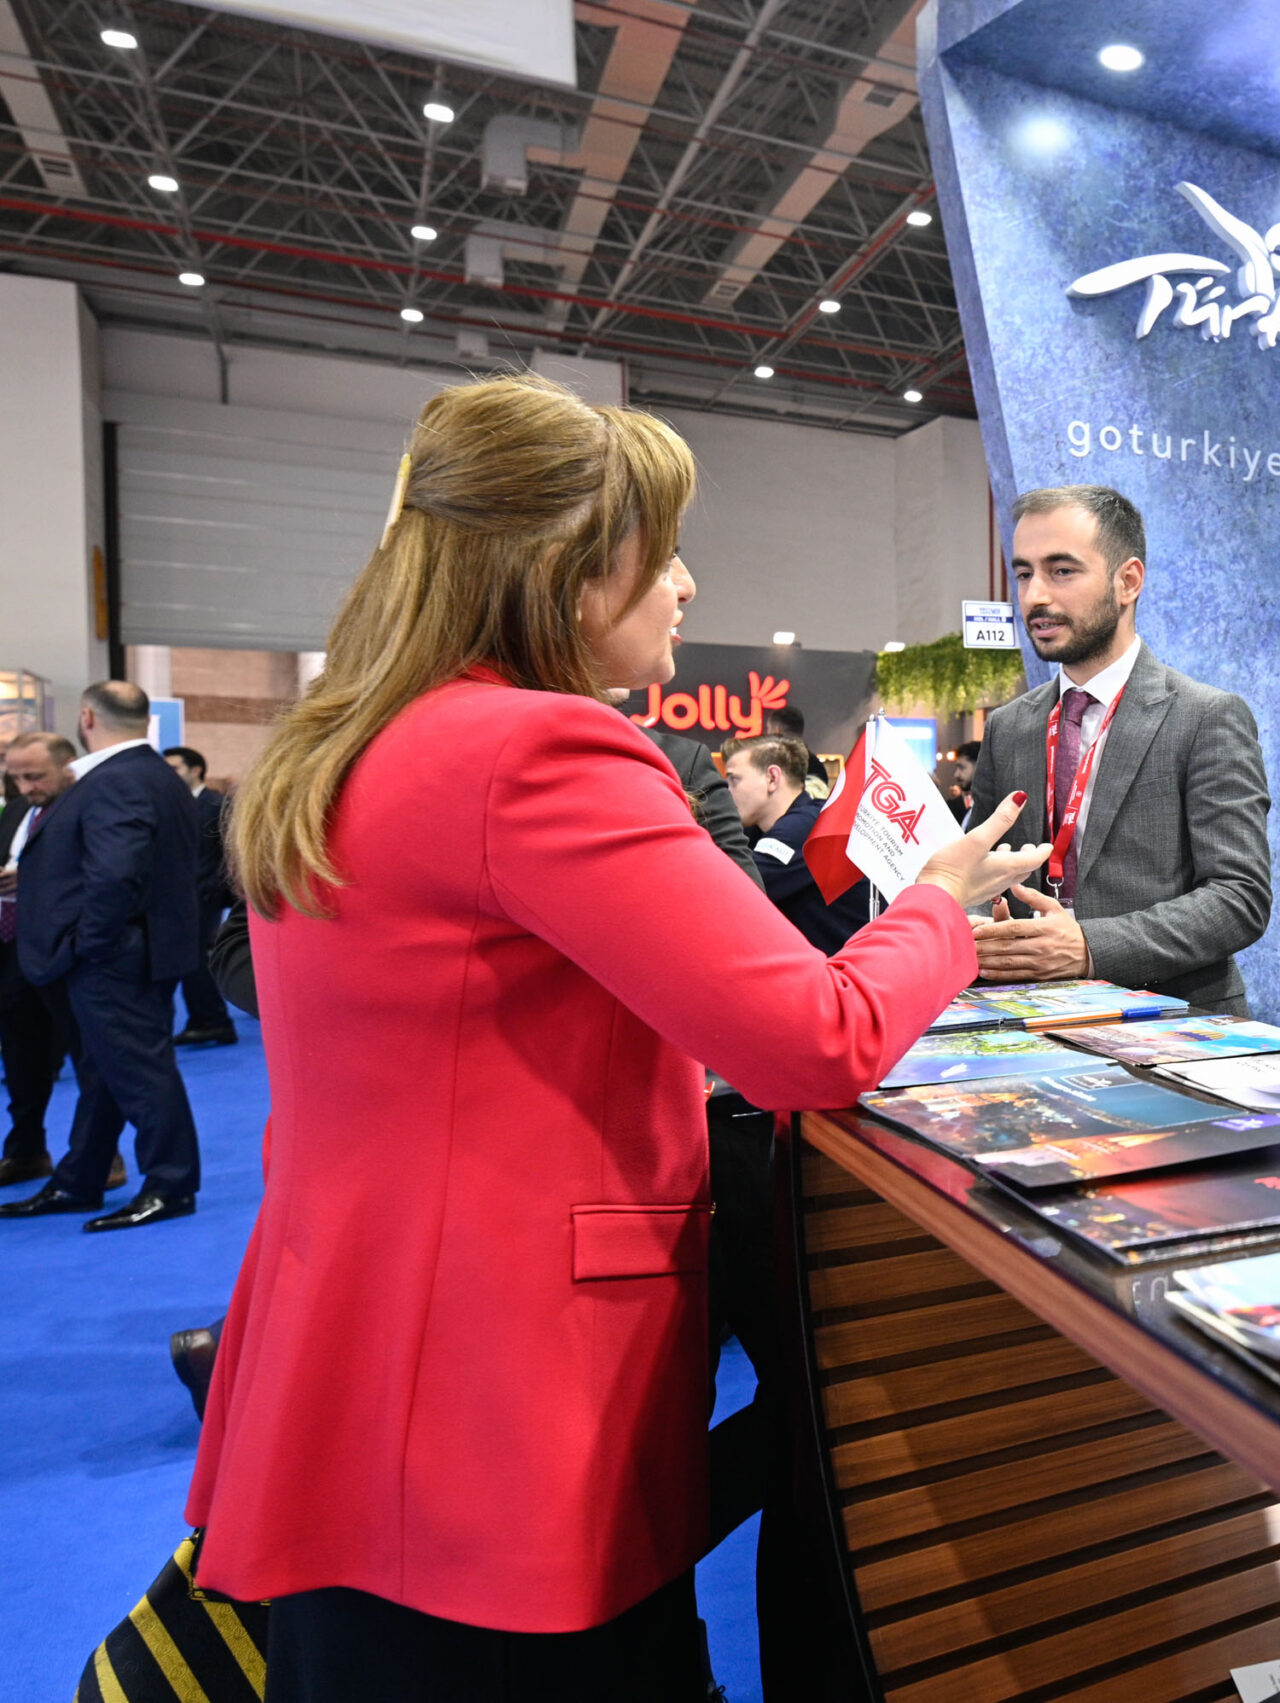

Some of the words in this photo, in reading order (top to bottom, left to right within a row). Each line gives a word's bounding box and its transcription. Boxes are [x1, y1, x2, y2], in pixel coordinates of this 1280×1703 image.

[976, 629, 1005, 641] A112
[629, 682, 764, 739] Jolly
[865, 757, 926, 845] TGA
[856, 812, 883, 842] ROMOTION
[882, 841, 896, 857] AND
[881, 826, 904, 856] TOURISM
[883, 854, 905, 881] AGENCY
